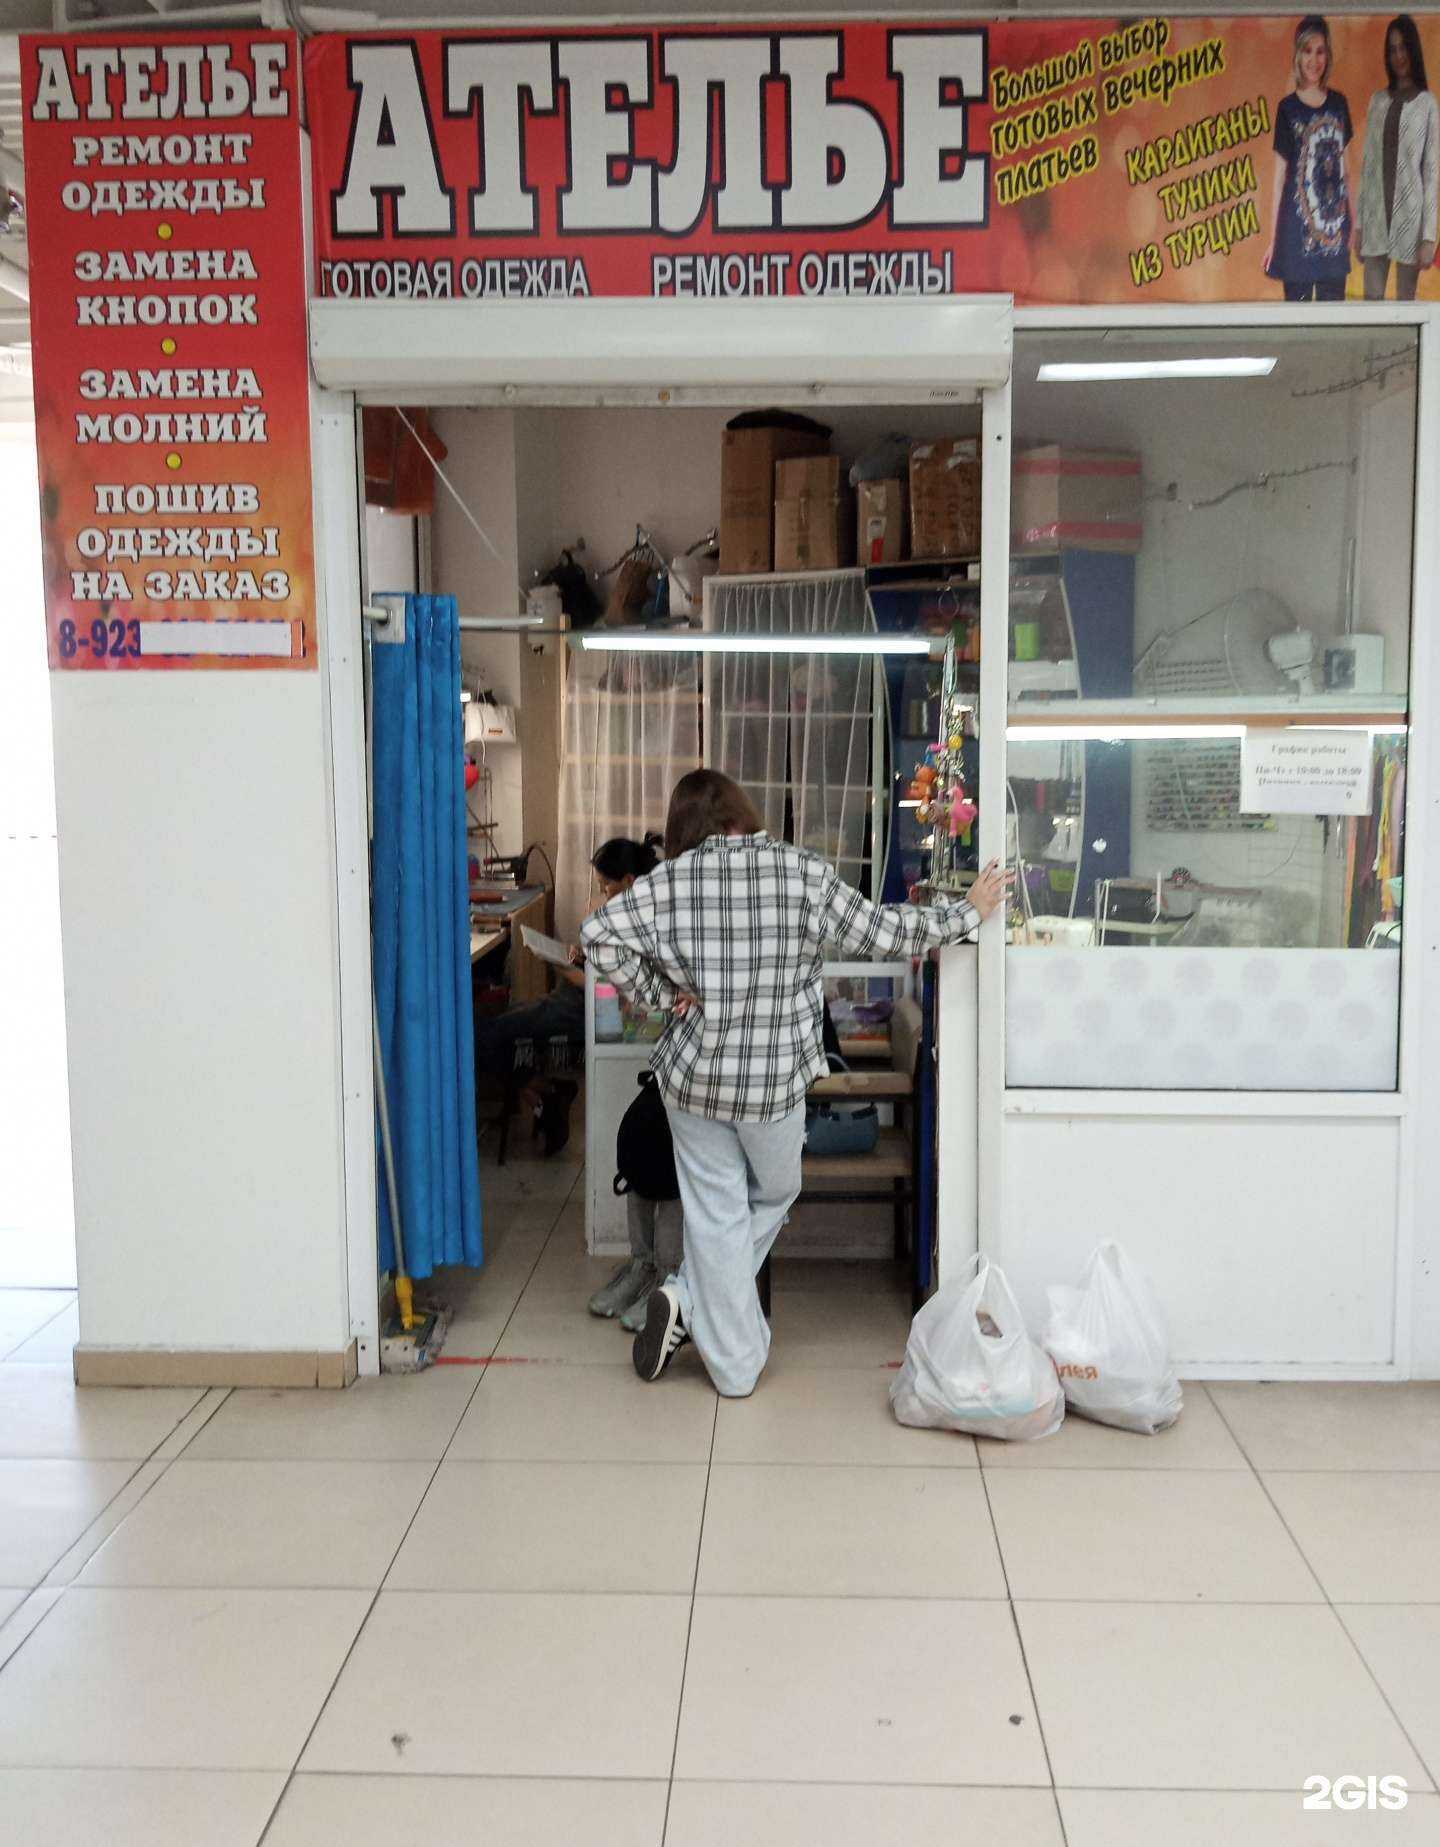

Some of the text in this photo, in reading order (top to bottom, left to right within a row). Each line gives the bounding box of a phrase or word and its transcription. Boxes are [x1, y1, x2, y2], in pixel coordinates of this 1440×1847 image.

[31, 42, 289, 120] АТЕЛЬЕ
[992, 18, 1168, 110] Большой выбор
[991, 41, 1225, 156] готовых вечерних
[73, 134, 252, 166] РЕМОНТ
[332, 31, 988, 237] АТЕЛЬЕ
[1126, 97, 1271, 185] КАРДИГАНЫ
[996, 138, 1098, 204] платьев
[1157, 155, 1258, 222] ТУНИКИ
[62, 179, 266, 216] ОДЕЖДЫ
[1129, 200, 1260, 287] ИЗ ТУРЦИИ
[75, 250, 258, 281] ЗАМЕНА
[320, 258, 591, 298] ГОТОВАЯ ОДЕЖДА
[652, 251, 951, 297] РЕМОНТ ОДЕЖДЫ
[76, 296, 259, 326] КНОПОК
[79, 368, 263, 399] ЗАМЕНА
[76, 405, 268, 443] МОЛНИЙ
[95, 484, 260, 514] ПОШИВ
[77, 527, 279, 563] ОДЕЖДЫ
[70, 570, 290, 600] НА ЗАКАЗ
